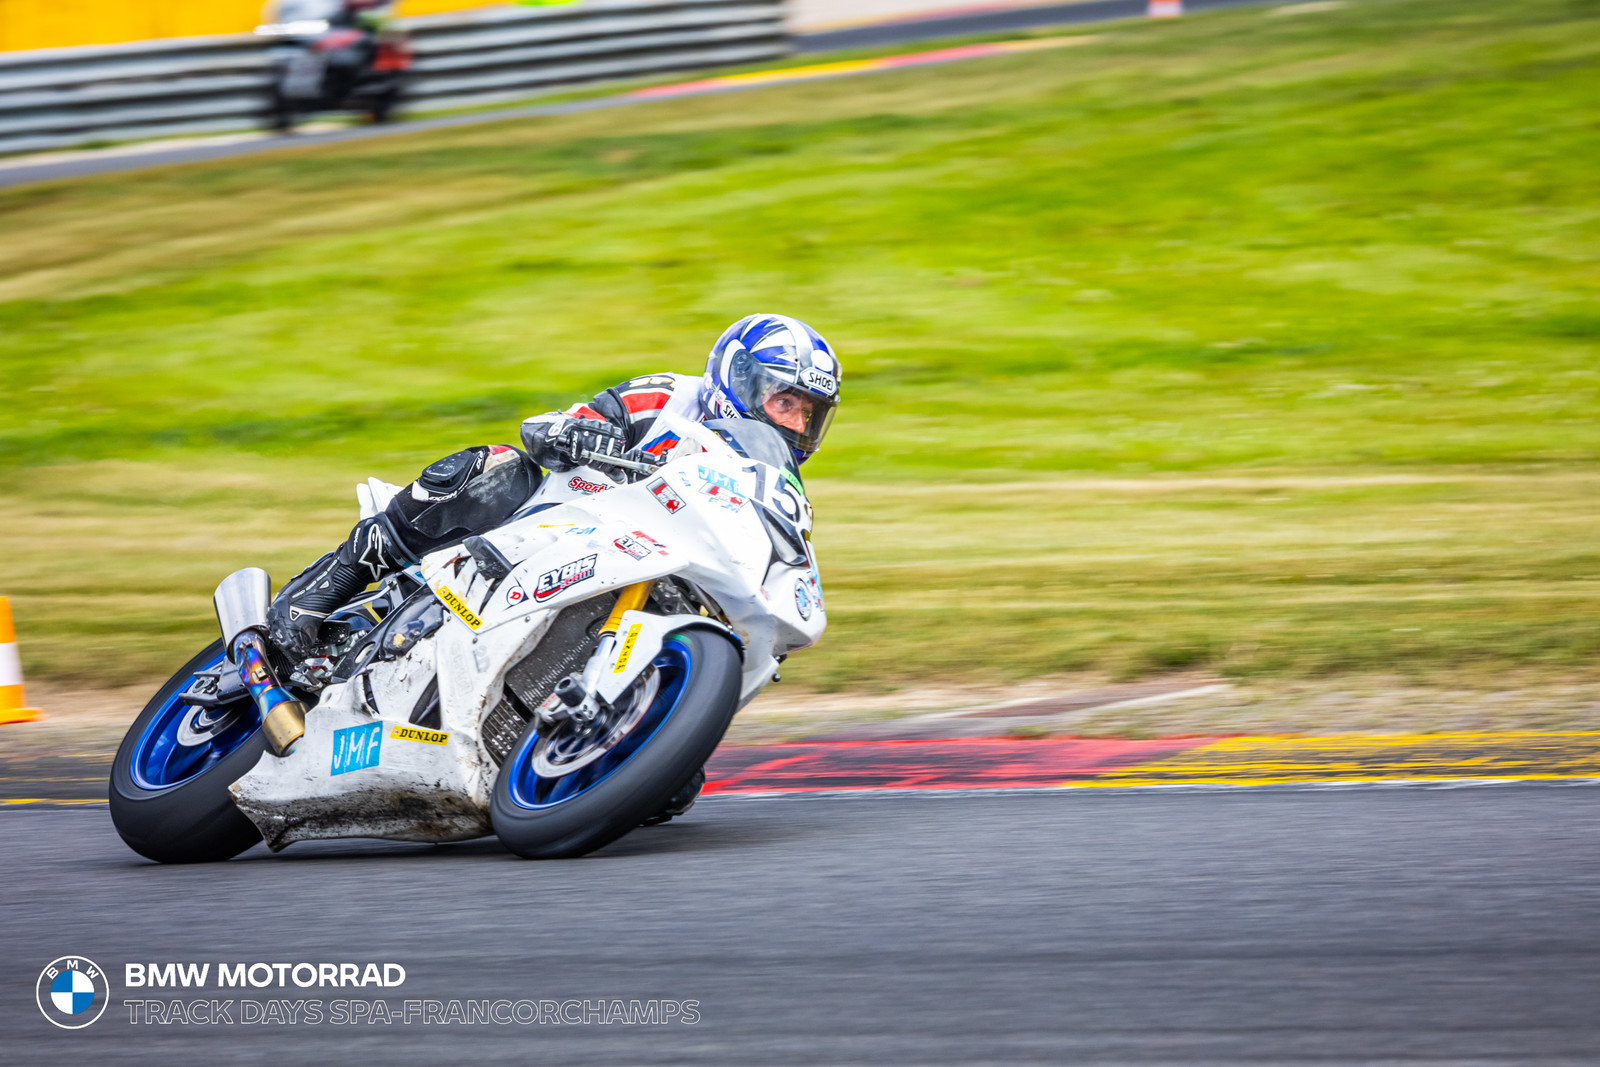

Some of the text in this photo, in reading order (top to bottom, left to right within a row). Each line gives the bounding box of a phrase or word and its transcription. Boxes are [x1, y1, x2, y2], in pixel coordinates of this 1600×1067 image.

[538, 553, 598, 590] EYBIS
[443, 592, 481, 627] DUNLOP
[333, 726, 381, 769] JMF
[399, 728, 449, 743] DUNLOP
